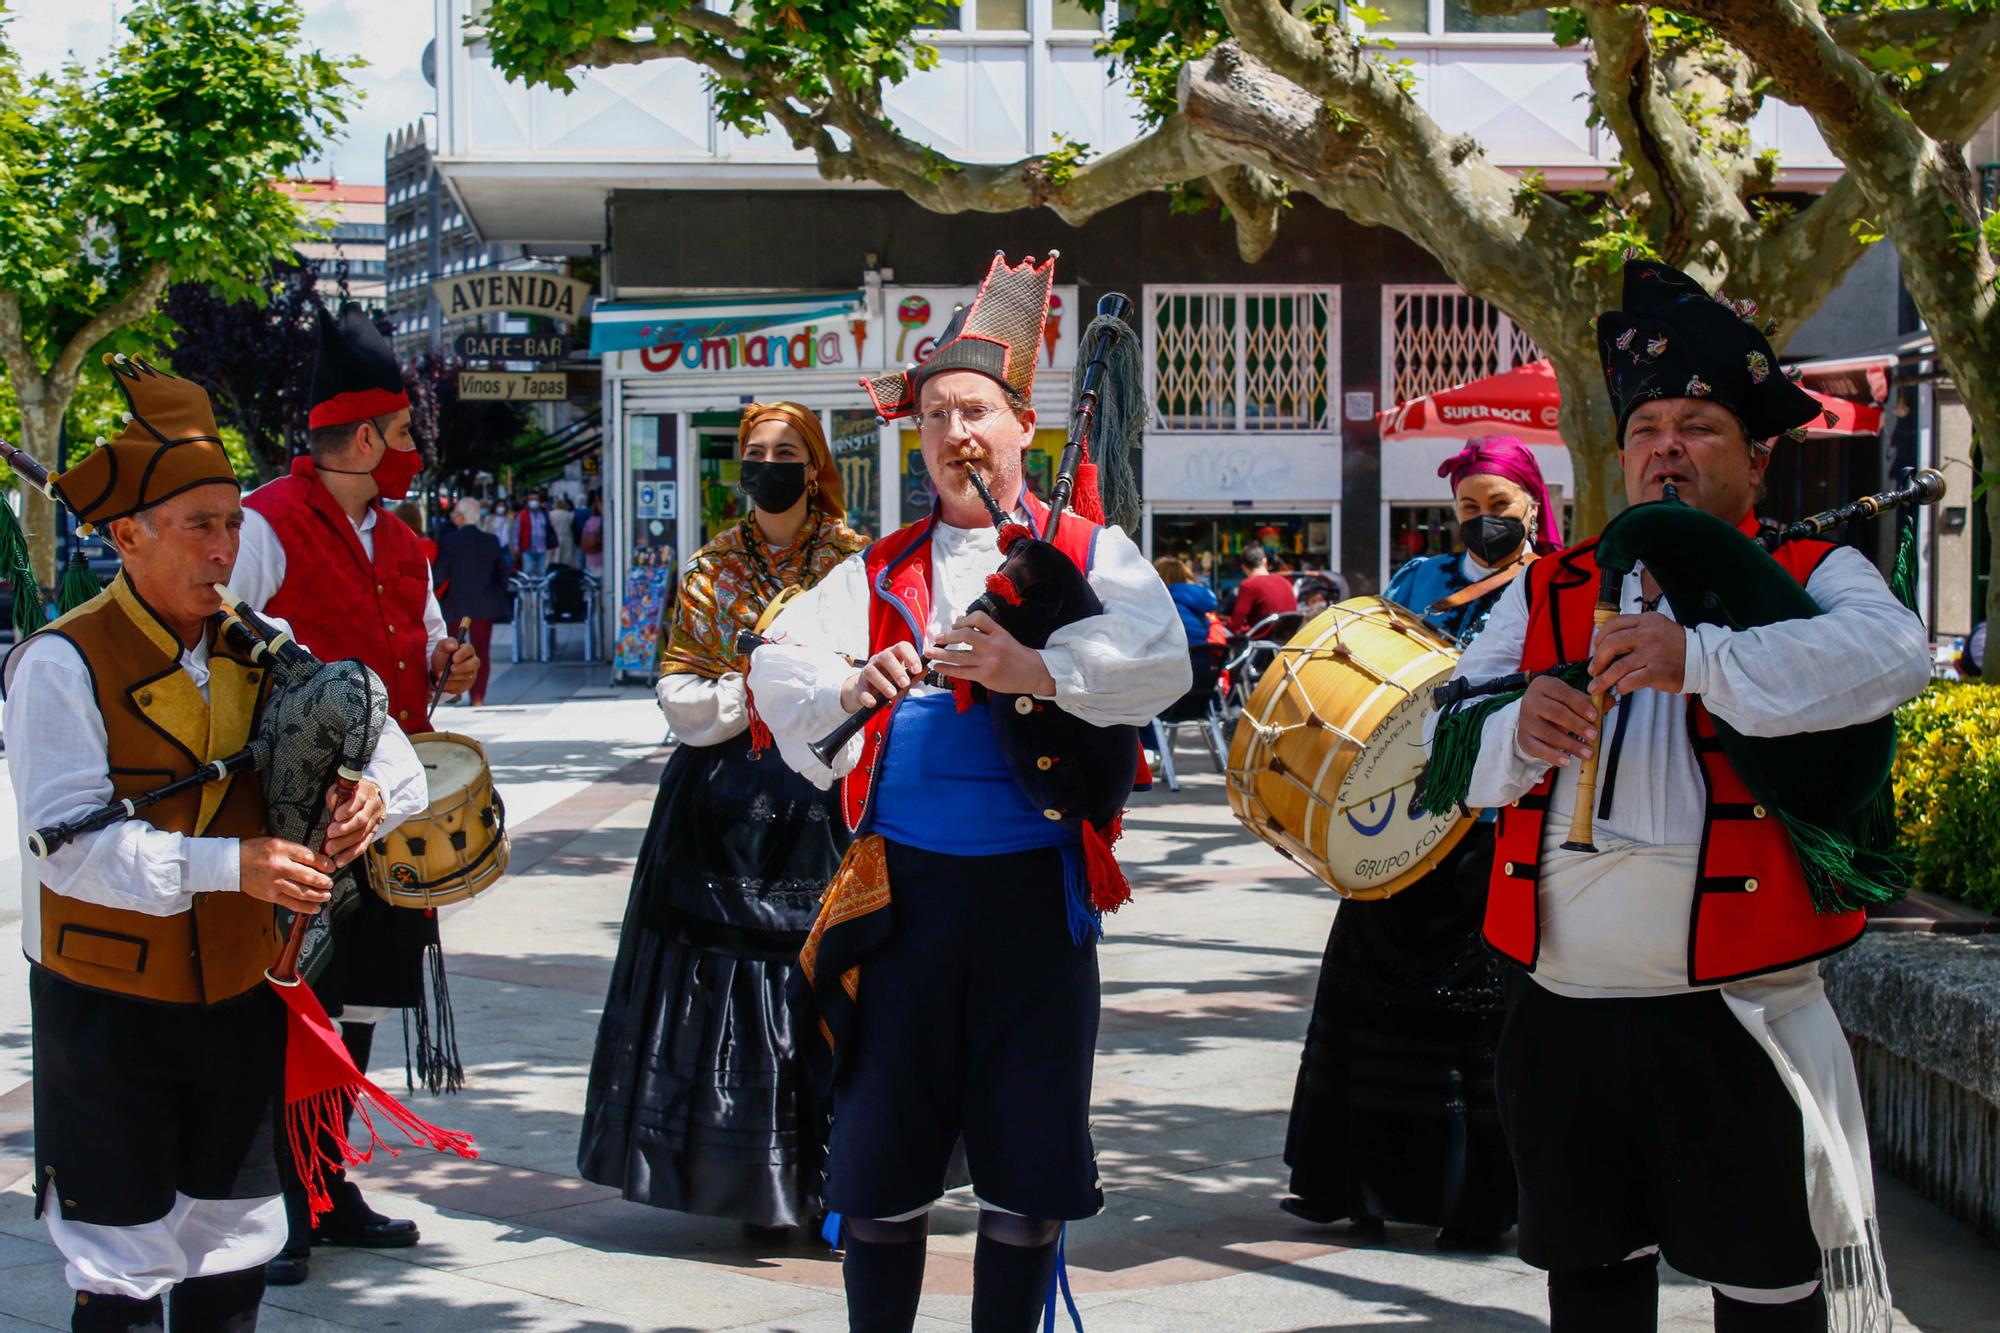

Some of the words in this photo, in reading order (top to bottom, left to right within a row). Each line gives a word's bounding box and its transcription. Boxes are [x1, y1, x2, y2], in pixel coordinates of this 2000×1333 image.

[452, 276, 574, 315] AVENIDA
[465, 336, 562, 356] CAFE-BAR
[640, 325, 843, 373] Gomilandia
[460, 375, 500, 394] Vinos
[506, 379, 516, 399] y
[522, 376, 564, 399] Tapas
[1443, 405, 1490, 419] SUPER
[663, 494, 670, 510] 5
[1355, 850, 1410, 880] GRUPO
